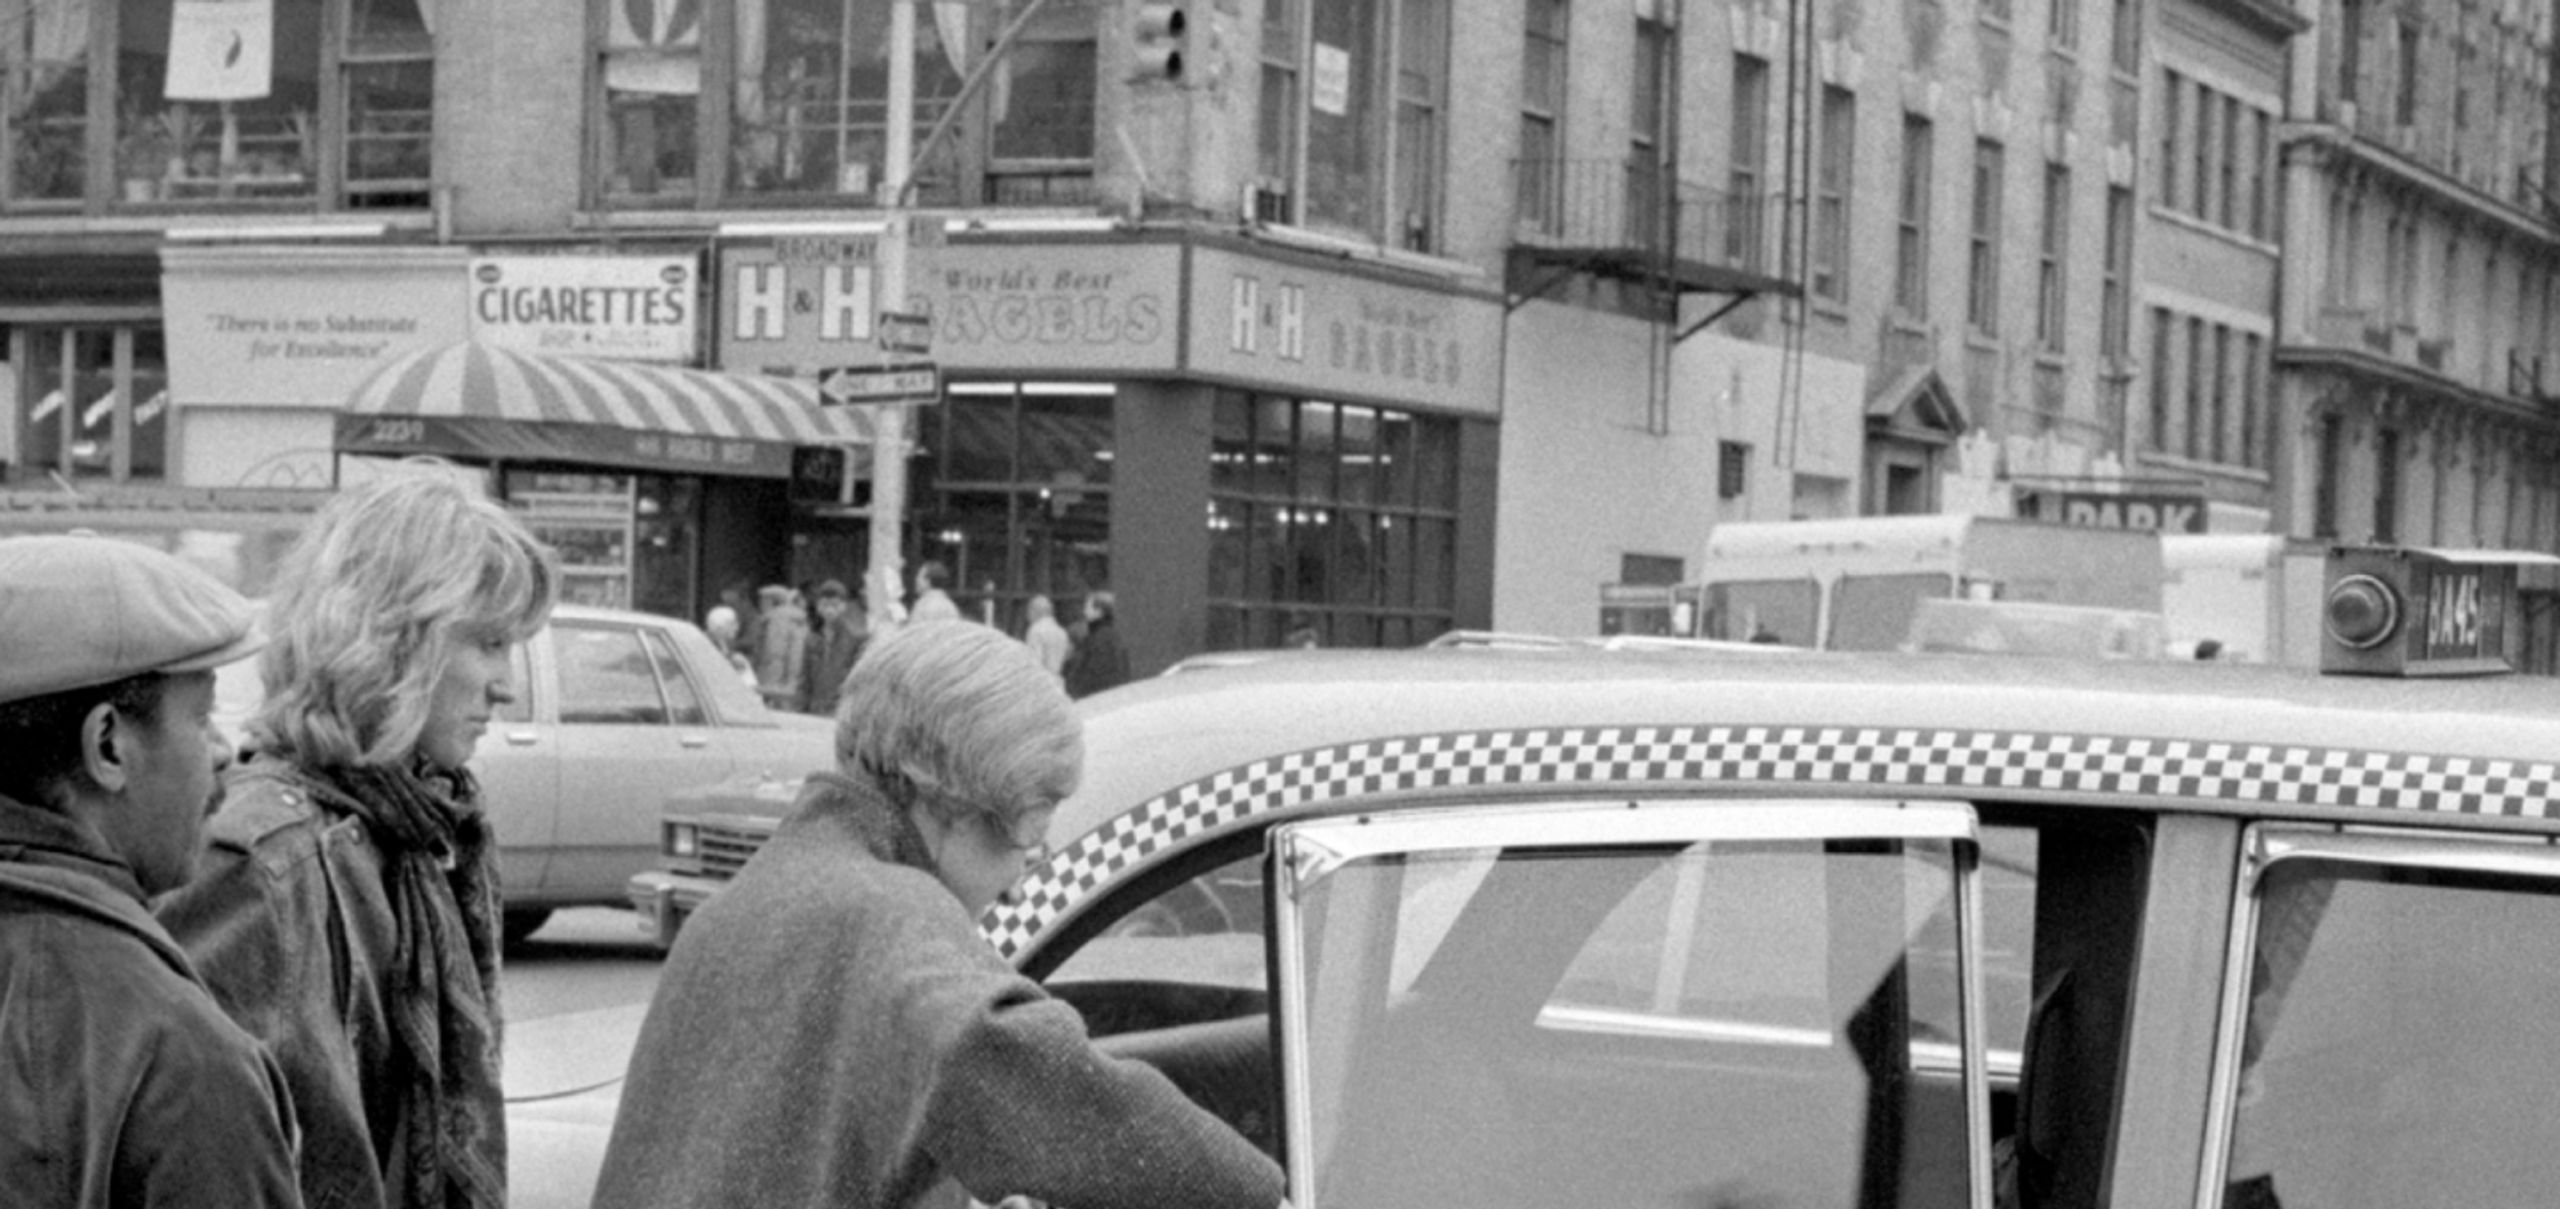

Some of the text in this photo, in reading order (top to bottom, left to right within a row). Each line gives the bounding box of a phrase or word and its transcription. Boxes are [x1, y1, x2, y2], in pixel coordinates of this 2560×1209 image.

[776, 237, 878, 263] BROADWAY
[478, 286, 685, 325] CIGARETTES
[734, 263, 787, 341] H
[793, 290, 813, 314] &
[818, 263, 873, 341] H
[1230, 273, 1260, 356] H
[1278, 280, 1304, 364] H
[325, 314, 417, 334] Substitute
[247, 339, 281, 363] for
[2069, 501, 2197, 536] PARK
